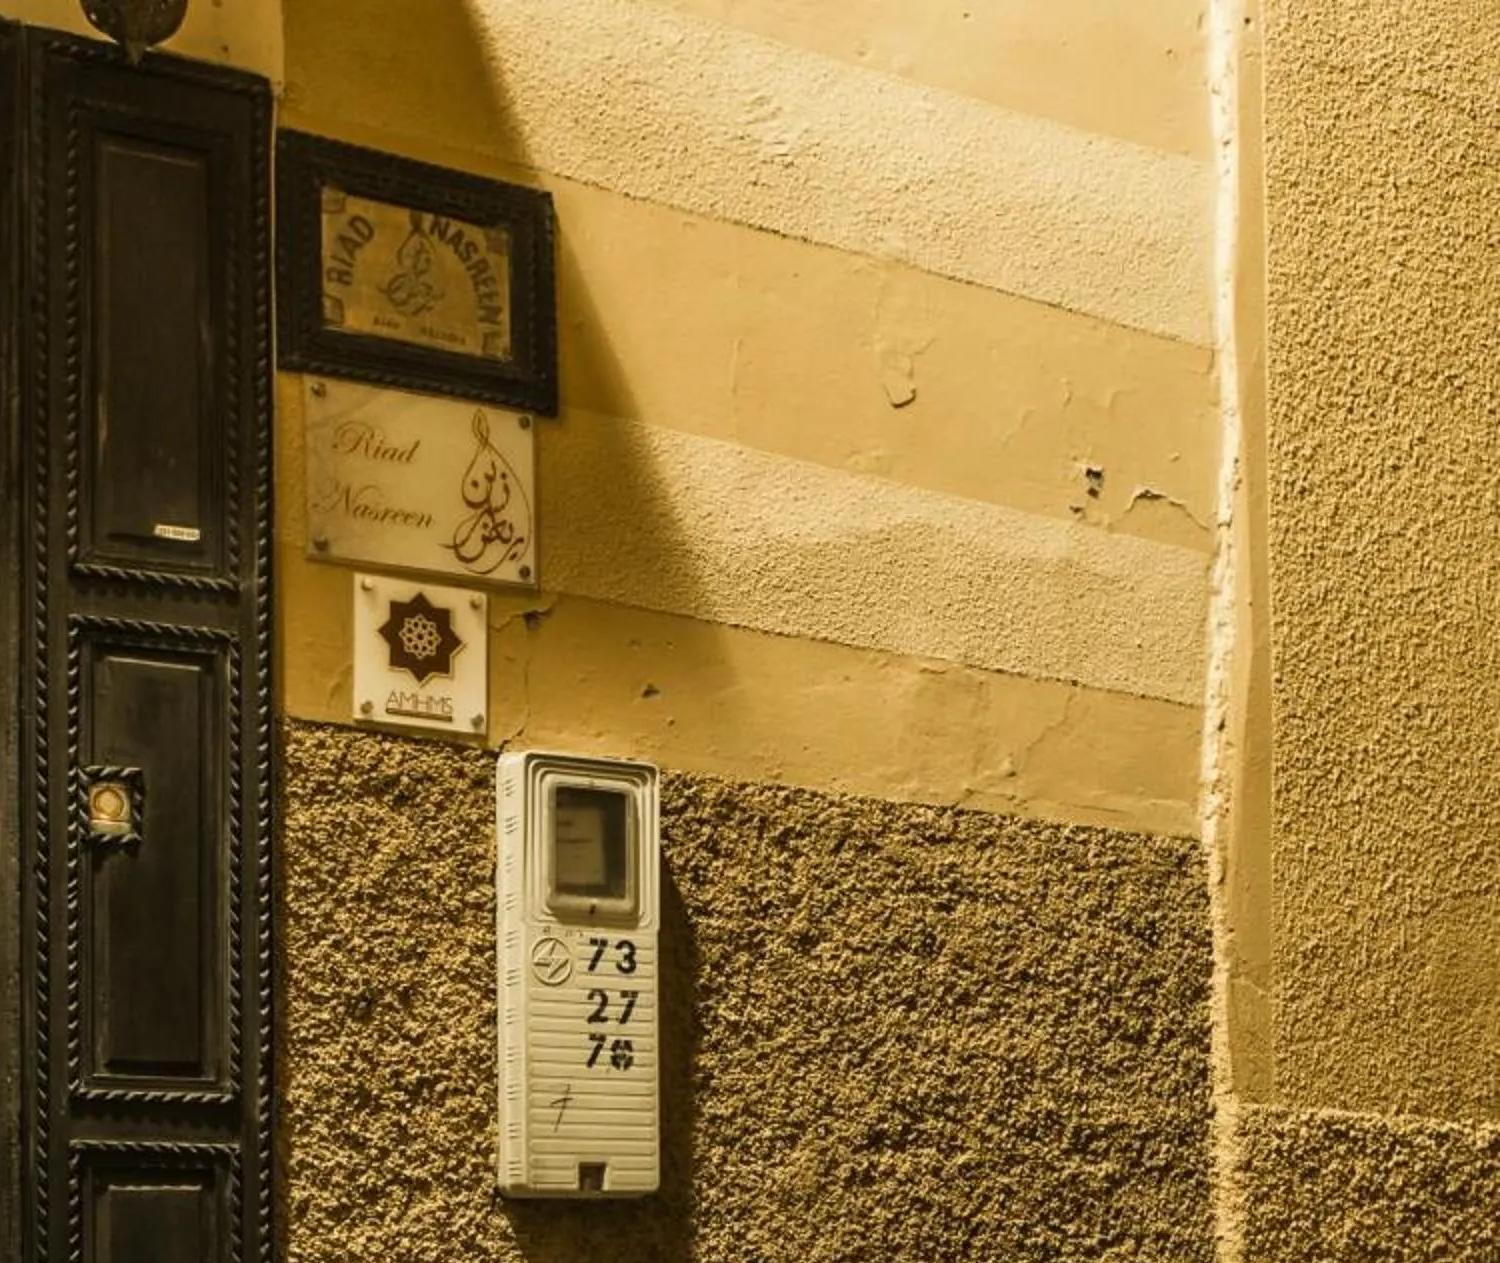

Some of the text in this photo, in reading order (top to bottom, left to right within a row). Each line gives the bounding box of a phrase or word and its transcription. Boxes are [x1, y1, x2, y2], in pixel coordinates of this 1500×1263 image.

[327, 214, 375, 286] RIAD
[331, 420, 421, 462] Riad
[308, 480, 435, 528] Nasreen
[588, 937, 637, 975] 73
[587, 988, 639, 1024] 27
